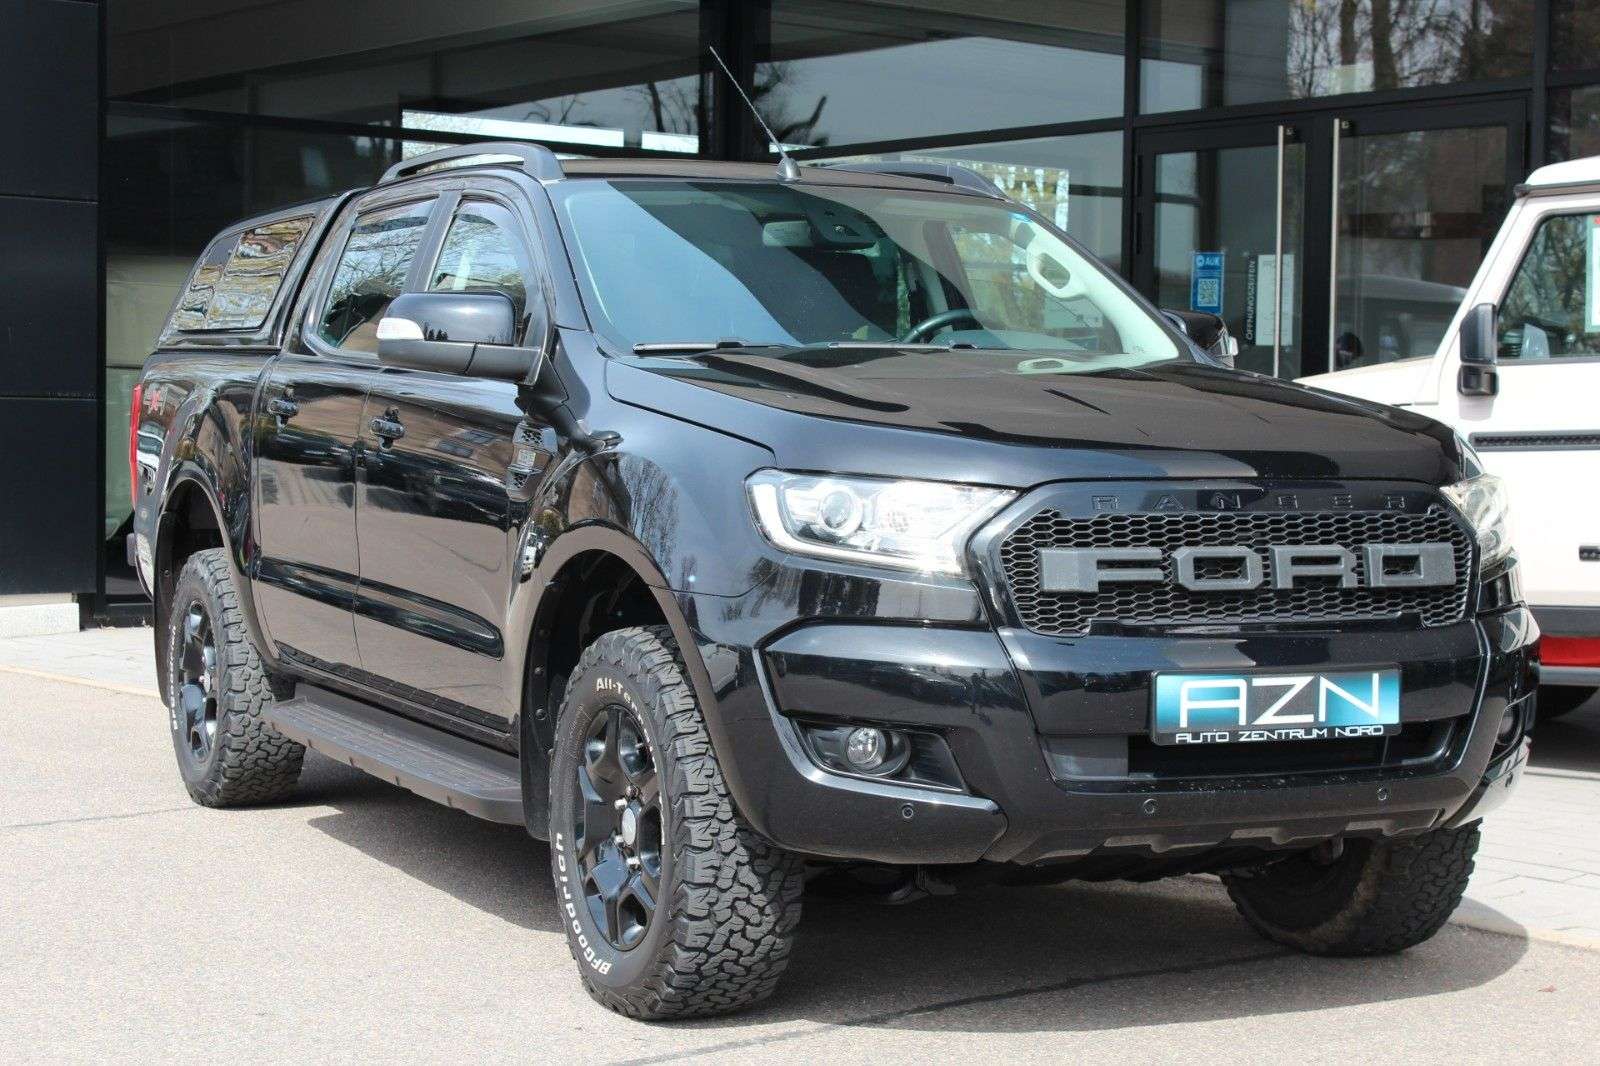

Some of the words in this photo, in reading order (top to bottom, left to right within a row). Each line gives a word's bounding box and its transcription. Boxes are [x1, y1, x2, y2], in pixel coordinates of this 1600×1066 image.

[1040, 542, 1457, 592] FORD
[1178, 672, 1380, 729] AZN
[1174, 729, 1231, 744] AUTO
[1238, 727, 1329, 742] ZENTRUM
[1335, 724, 1385, 737] NORD
